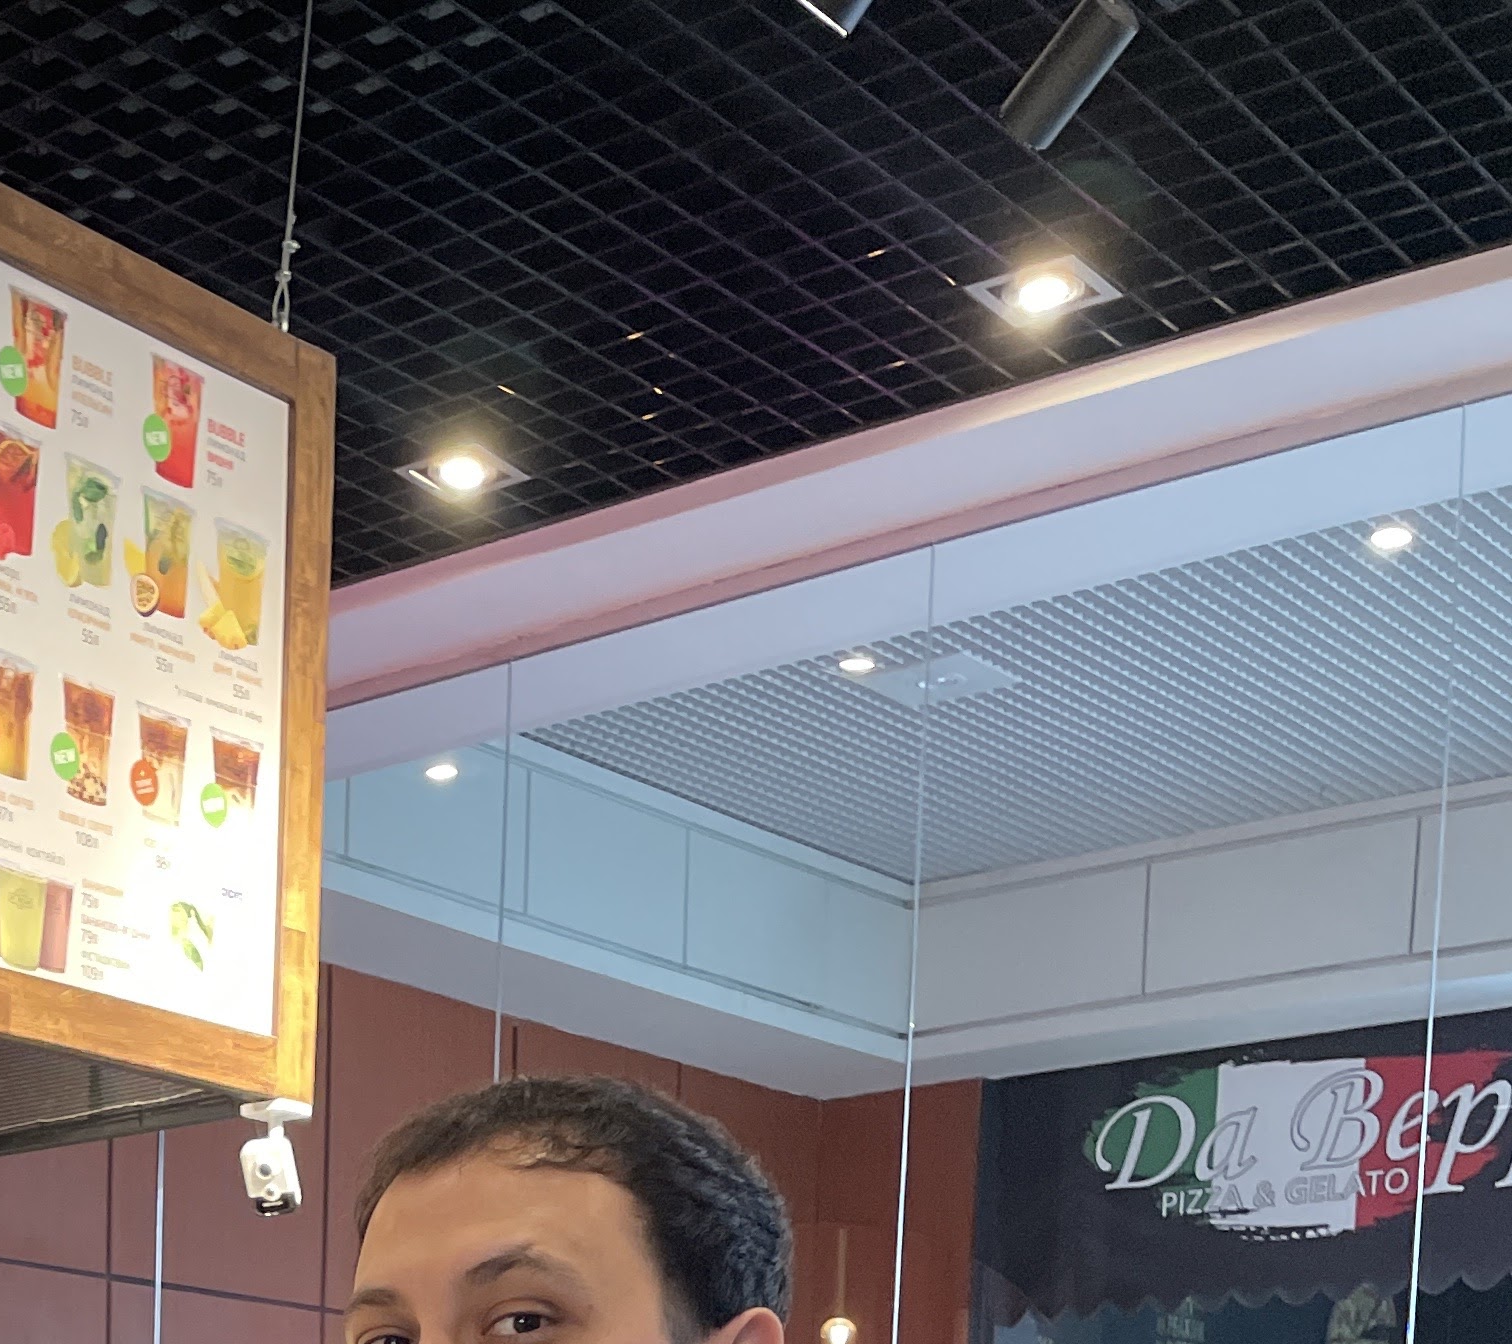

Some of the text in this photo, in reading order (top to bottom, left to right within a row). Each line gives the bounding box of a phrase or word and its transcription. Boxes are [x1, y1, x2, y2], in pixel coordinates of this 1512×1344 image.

[1095, 1067, 1511, 1194] Da Bep
[1162, 1168, 1409, 1217] PIZZA & GELATO
